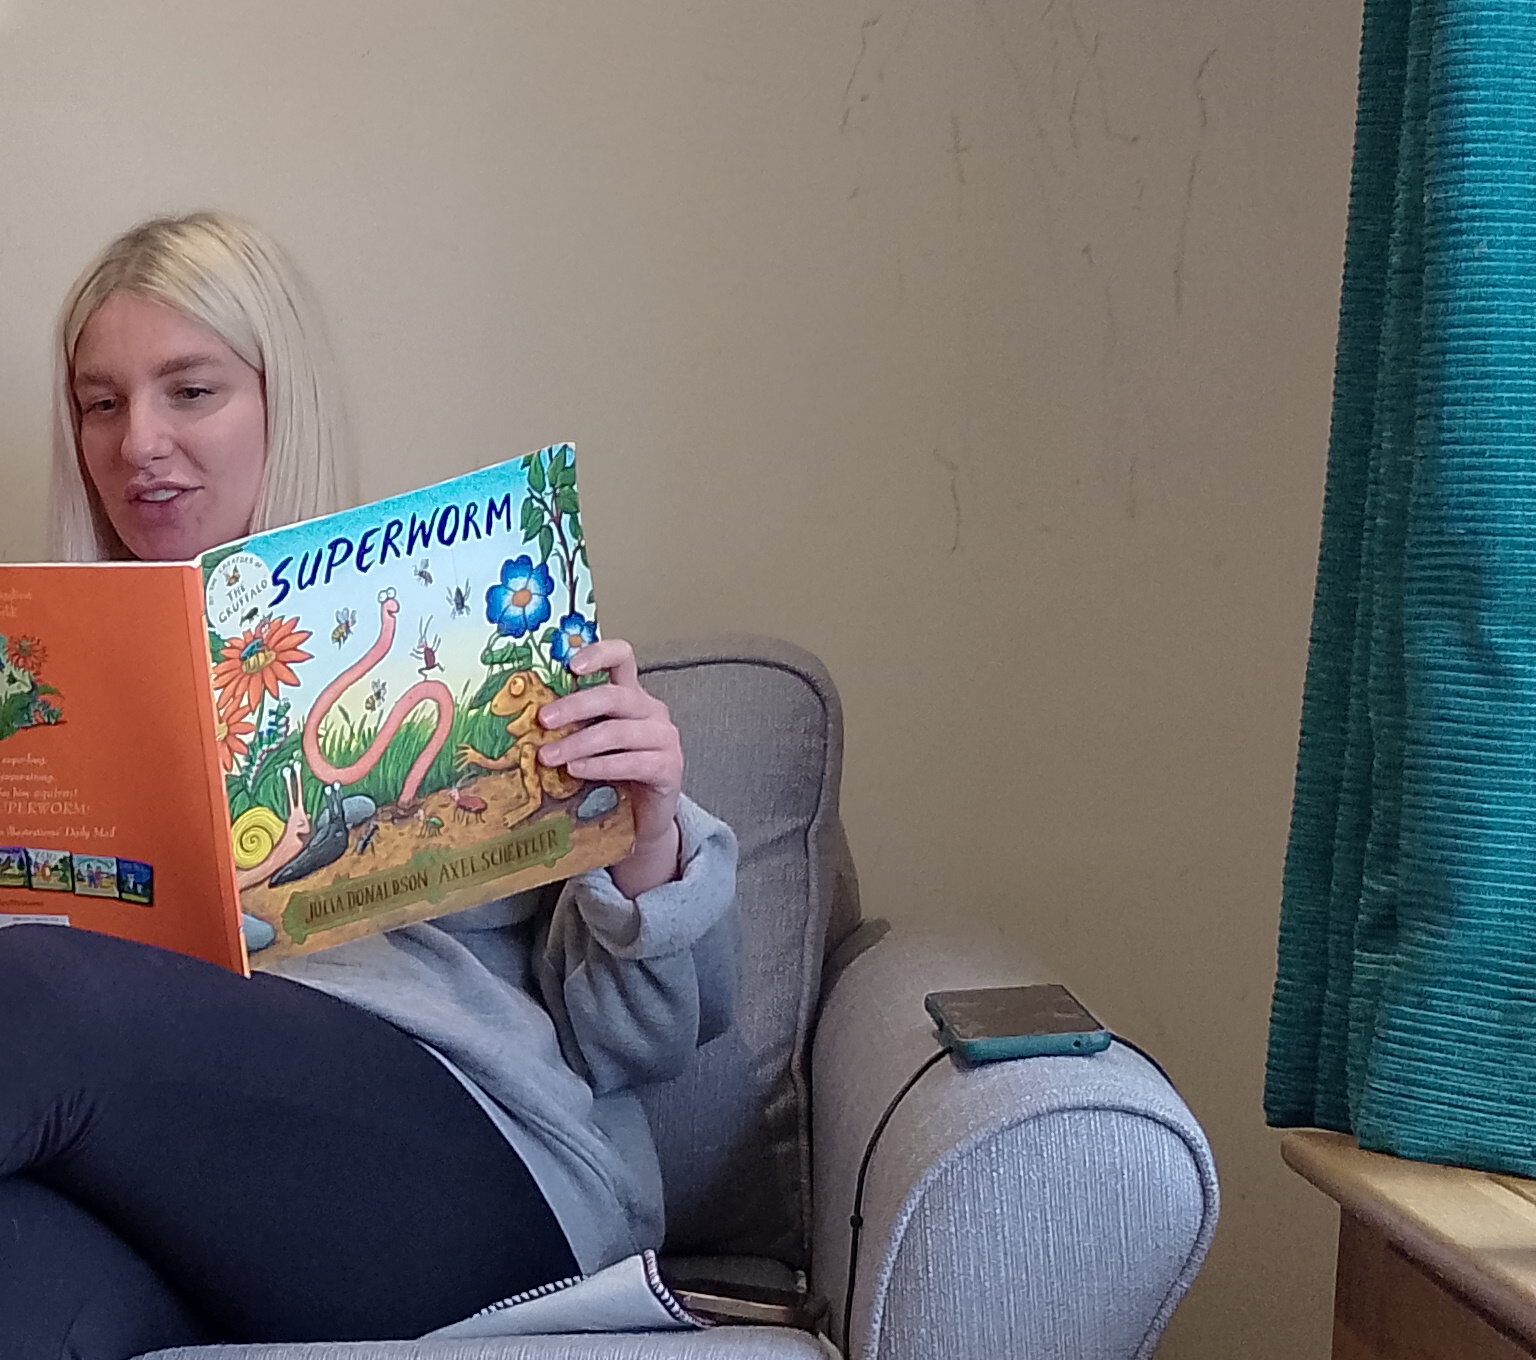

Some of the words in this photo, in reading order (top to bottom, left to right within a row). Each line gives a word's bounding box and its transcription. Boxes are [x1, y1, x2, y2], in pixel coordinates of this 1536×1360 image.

[268, 493, 512, 608] SUPERWORM
[218, 578, 268, 624] GRUFFALO
[226, 584, 246, 602] THE
[305, 894, 345, 924] JULIA
[346, 868, 429, 910] DONALDSON
[438, 855, 480, 886] AXEL
[480, 828, 559, 870] SCHEFFLER
